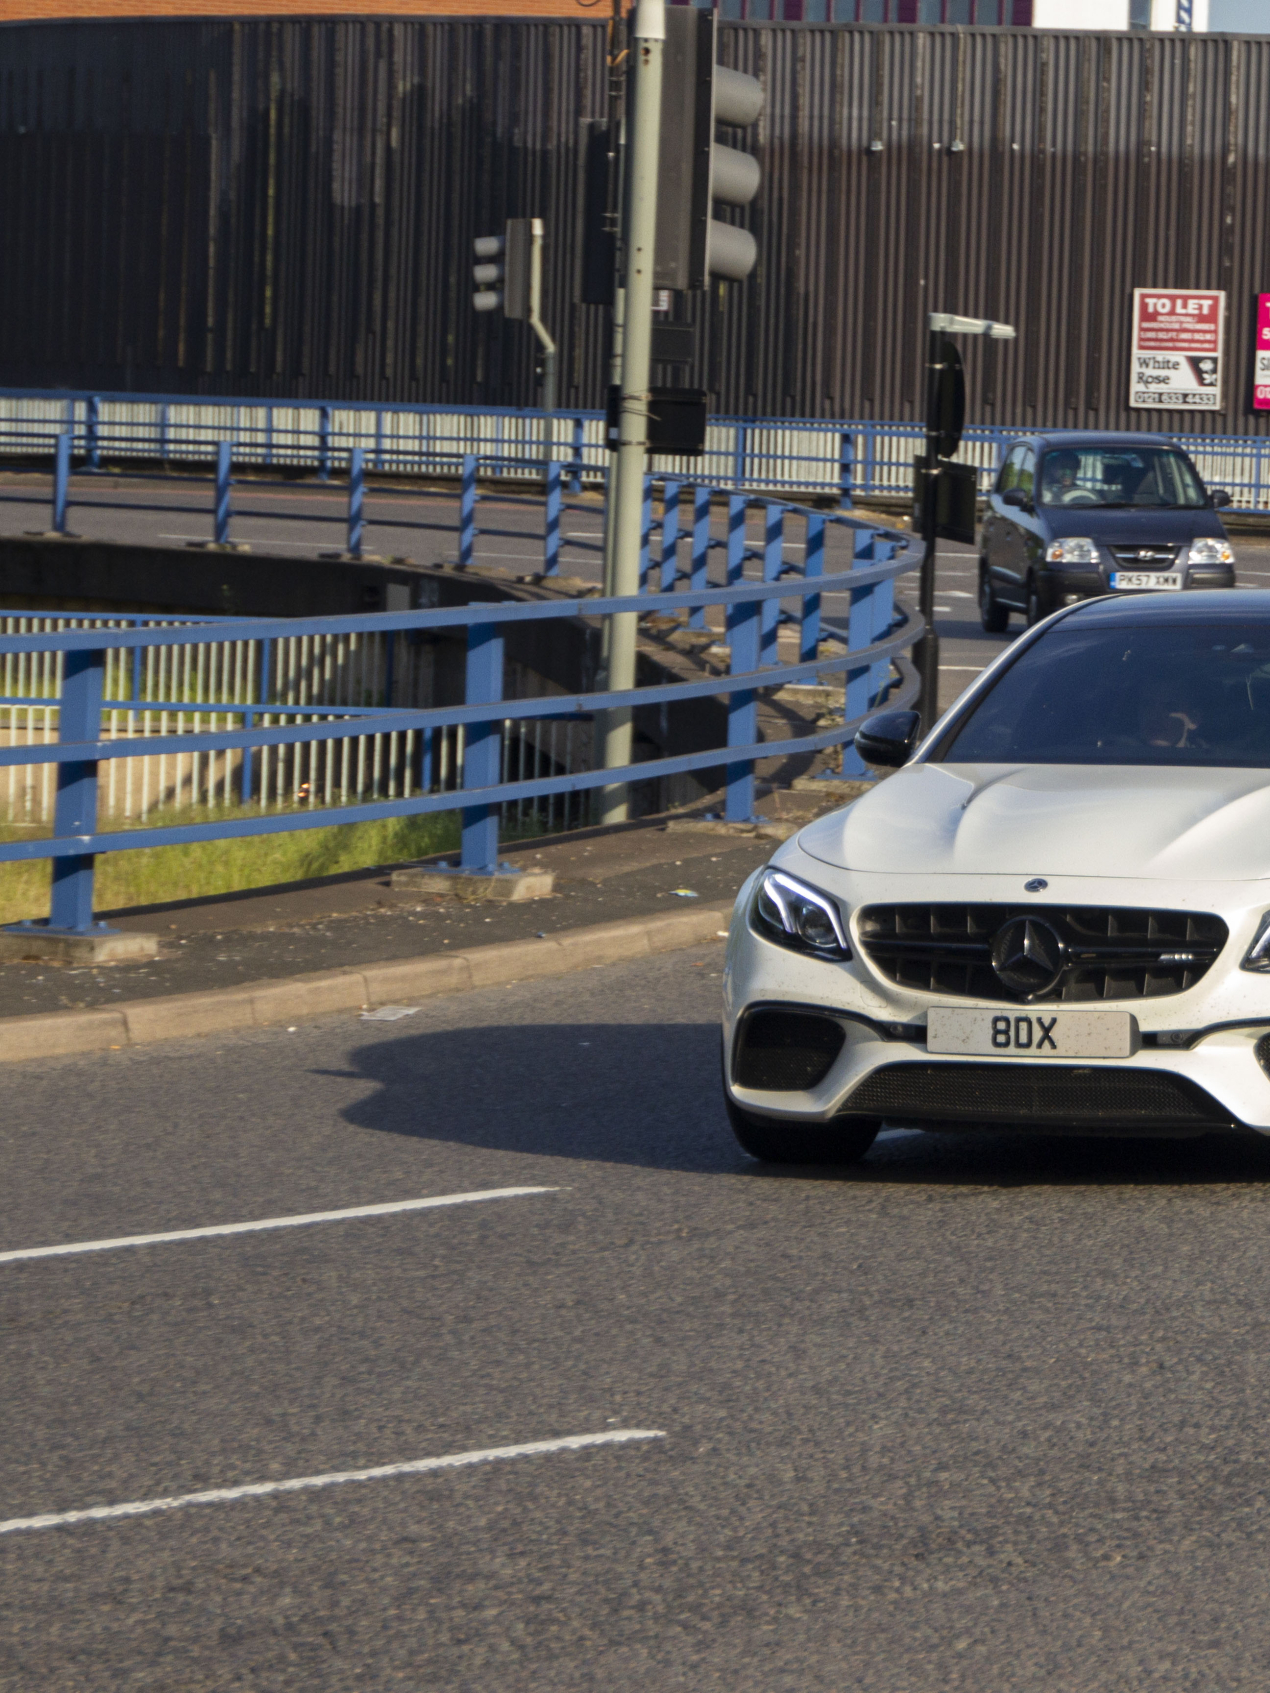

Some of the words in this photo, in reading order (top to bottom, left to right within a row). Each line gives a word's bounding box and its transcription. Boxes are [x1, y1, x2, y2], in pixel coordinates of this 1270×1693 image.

[1144, 298, 1171, 313] TO
[1175, 299, 1214, 315] LET
[1136, 356, 1181, 370] White
[1136, 371, 1171, 389] Rose
[1135, 392, 1159, 403] 0121
[1161, 393, 1183, 404] 633
[1186, 394, 1215, 405] 4433
[1119, 574, 1150, 586] PK57
